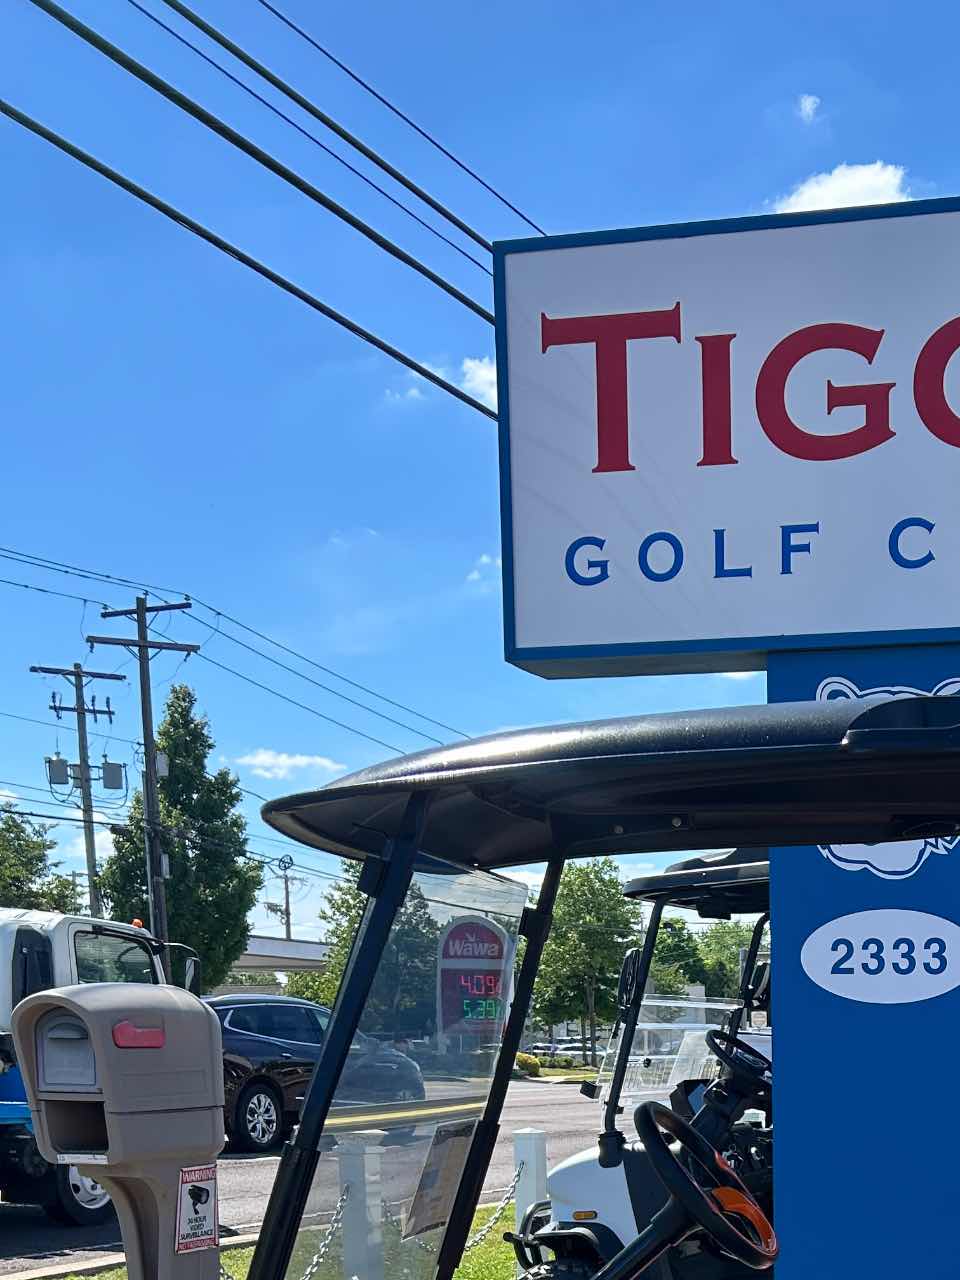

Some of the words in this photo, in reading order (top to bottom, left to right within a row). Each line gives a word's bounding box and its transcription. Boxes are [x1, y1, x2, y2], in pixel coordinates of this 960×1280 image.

[564, 521, 820, 587] GOLF
[449, 939, 499, 957] Wawa
[830, 937, 948, 976] 2333
[183, 1167, 216, 1182] WARNING
